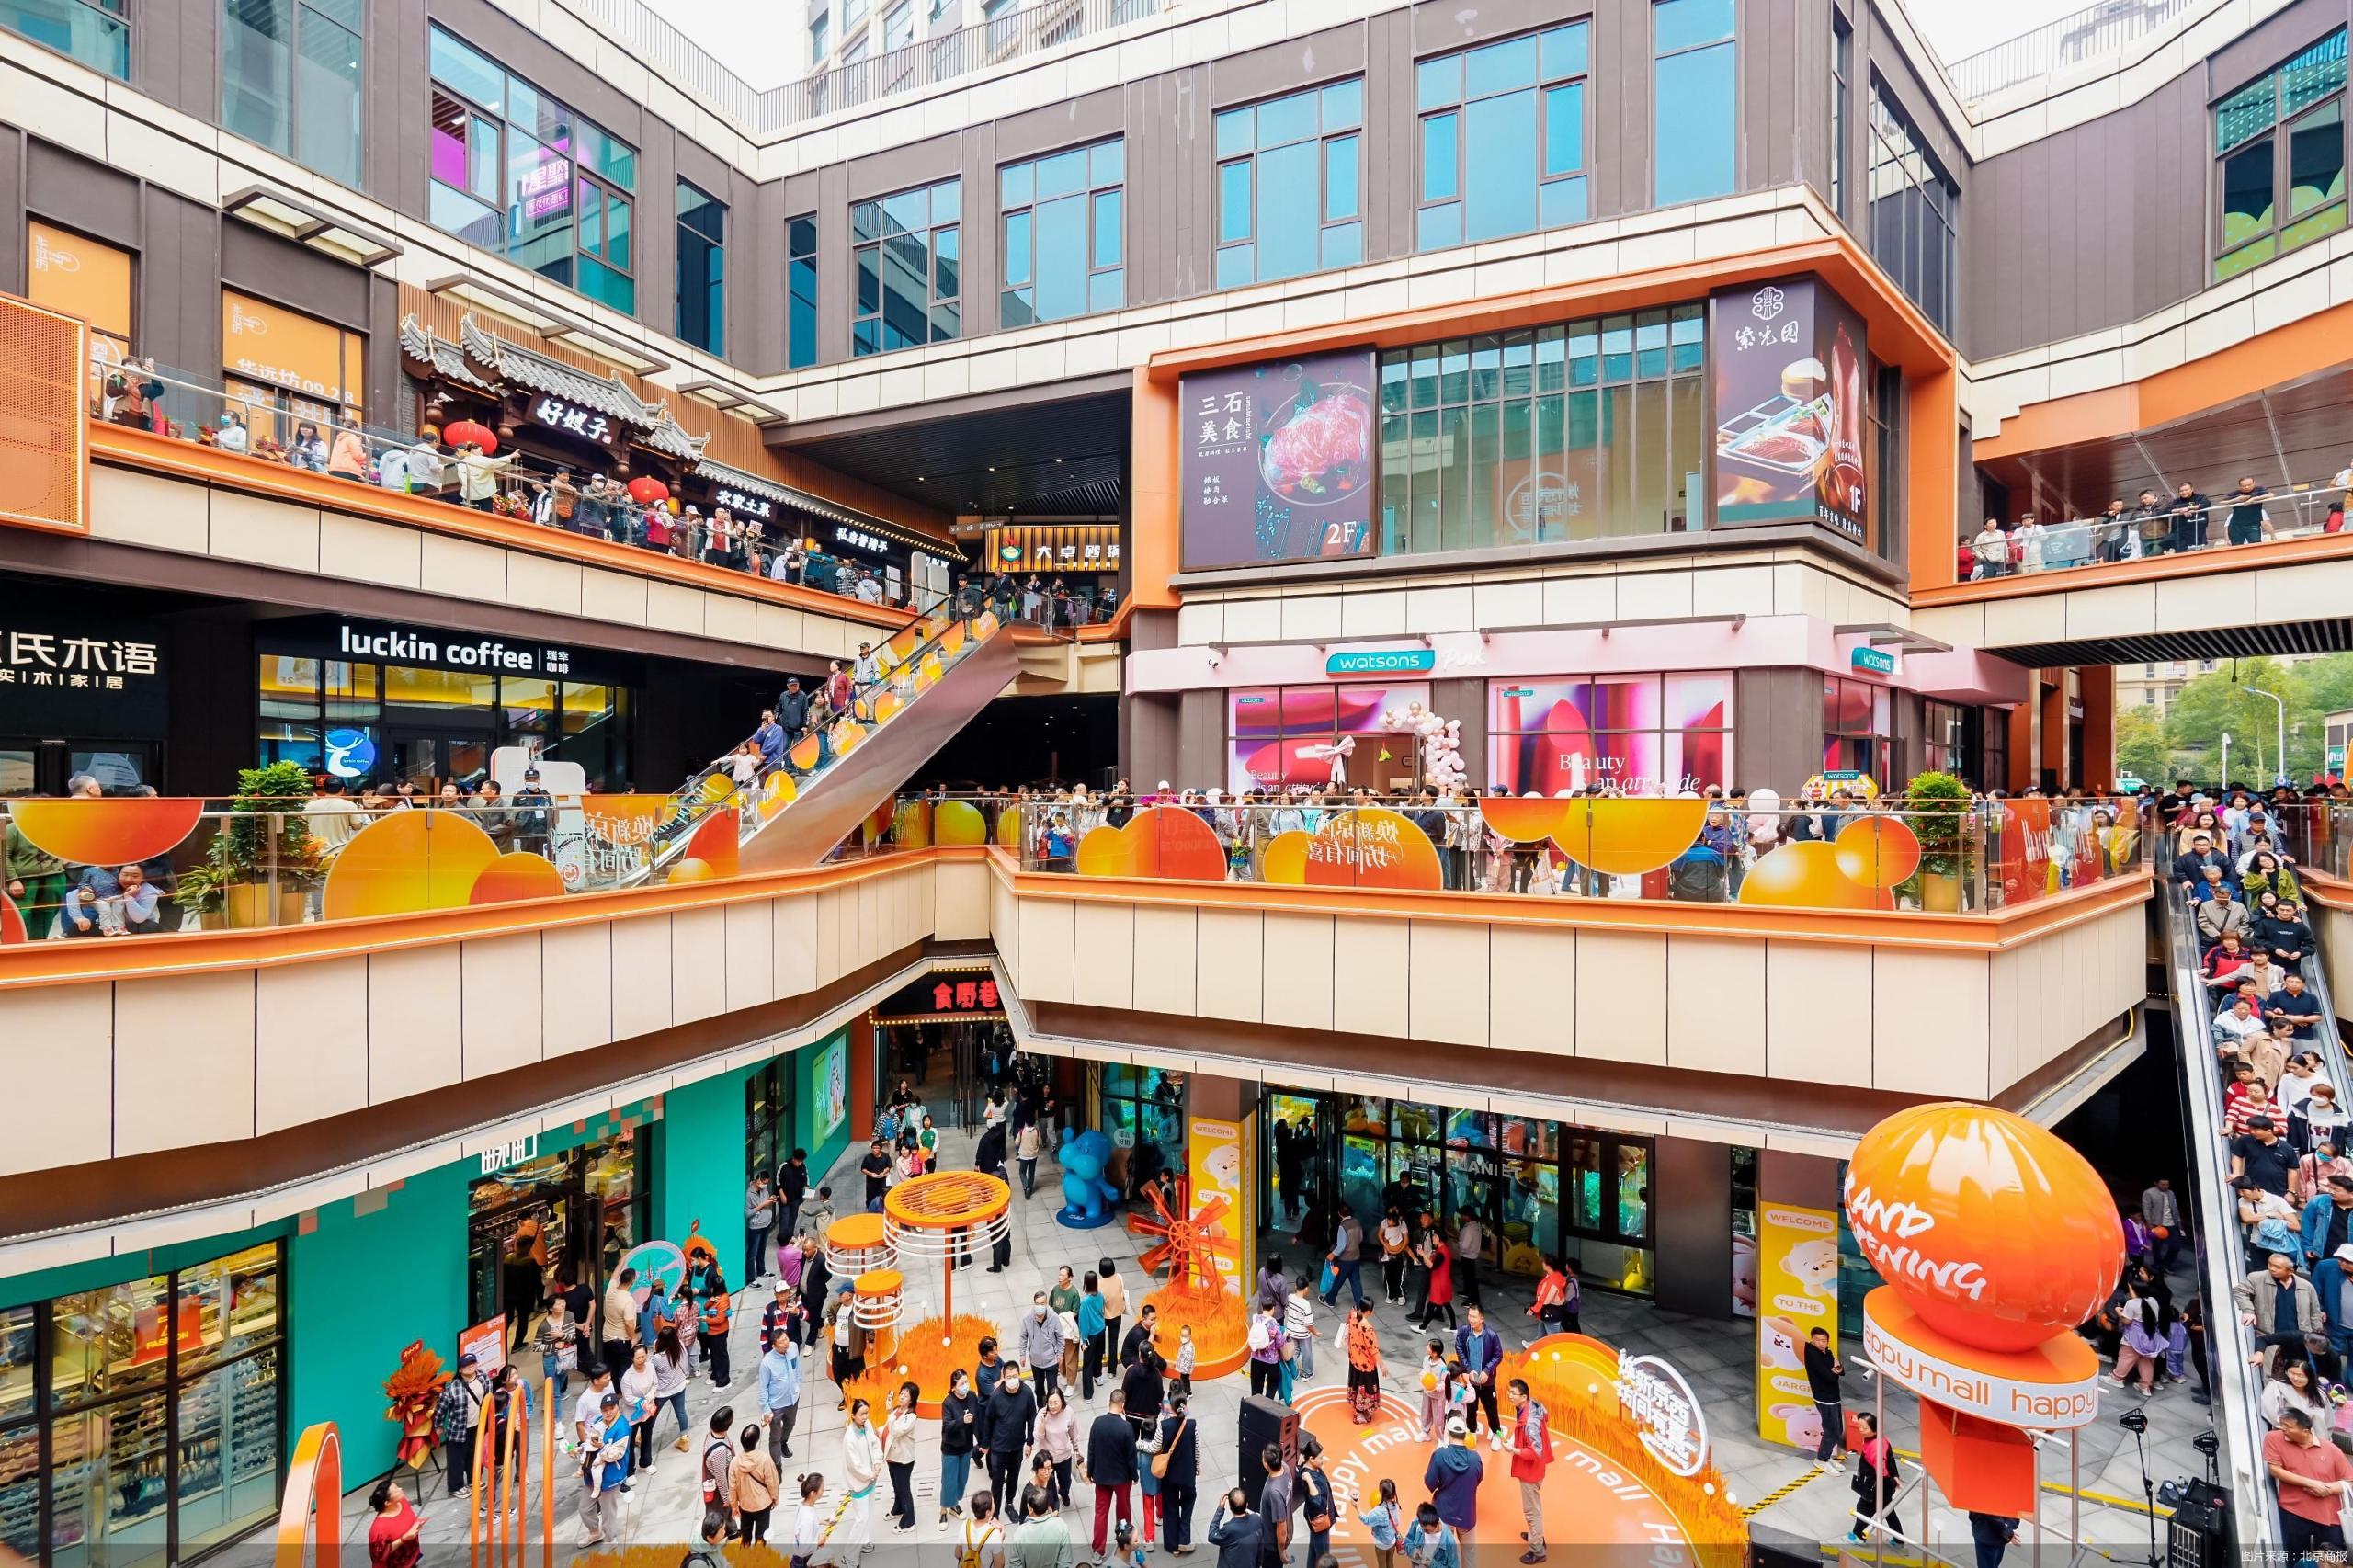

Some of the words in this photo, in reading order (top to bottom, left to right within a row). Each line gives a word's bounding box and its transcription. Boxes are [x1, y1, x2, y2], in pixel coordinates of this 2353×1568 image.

[1735, 320, 1799, 351] 紫光园
[1199, 391, 1244, 416] 三石
[536, 398, 608, 439] 好嫂子
[1199, 416, 1243, 444] 美食
[1849, 484, 1861, 513] 1F
[1328, 522, 1356, 544] 2F
[0, 631, 158, 674] 氏木语
[341, 626, 437, 661] luckin
[446, 642, 533, 670] coffee
[546, 649, 569, 662] 瑞幸
[546, 661, 569, 674] 咖啡
[1340, 653, 1420, 669] watsons
[1863, 653, 1892, 671] watsons
[1560, 754, 1626, 774] Bauty
[1827, 772, 1855, 780] watsons
[1195, 1125, 1235, 1137] WELCOME
[1770, 1213, 1829, 1229] WELCOME
[1779, 1298, 1794, 1307] TO
[1798, 1300, 1820, 1312] THE
[1918, 1363, 1989, 1405] mall
[2011, 1388, 2095, 1420] happy
[1563, 1449, 1652, 1502] mall
